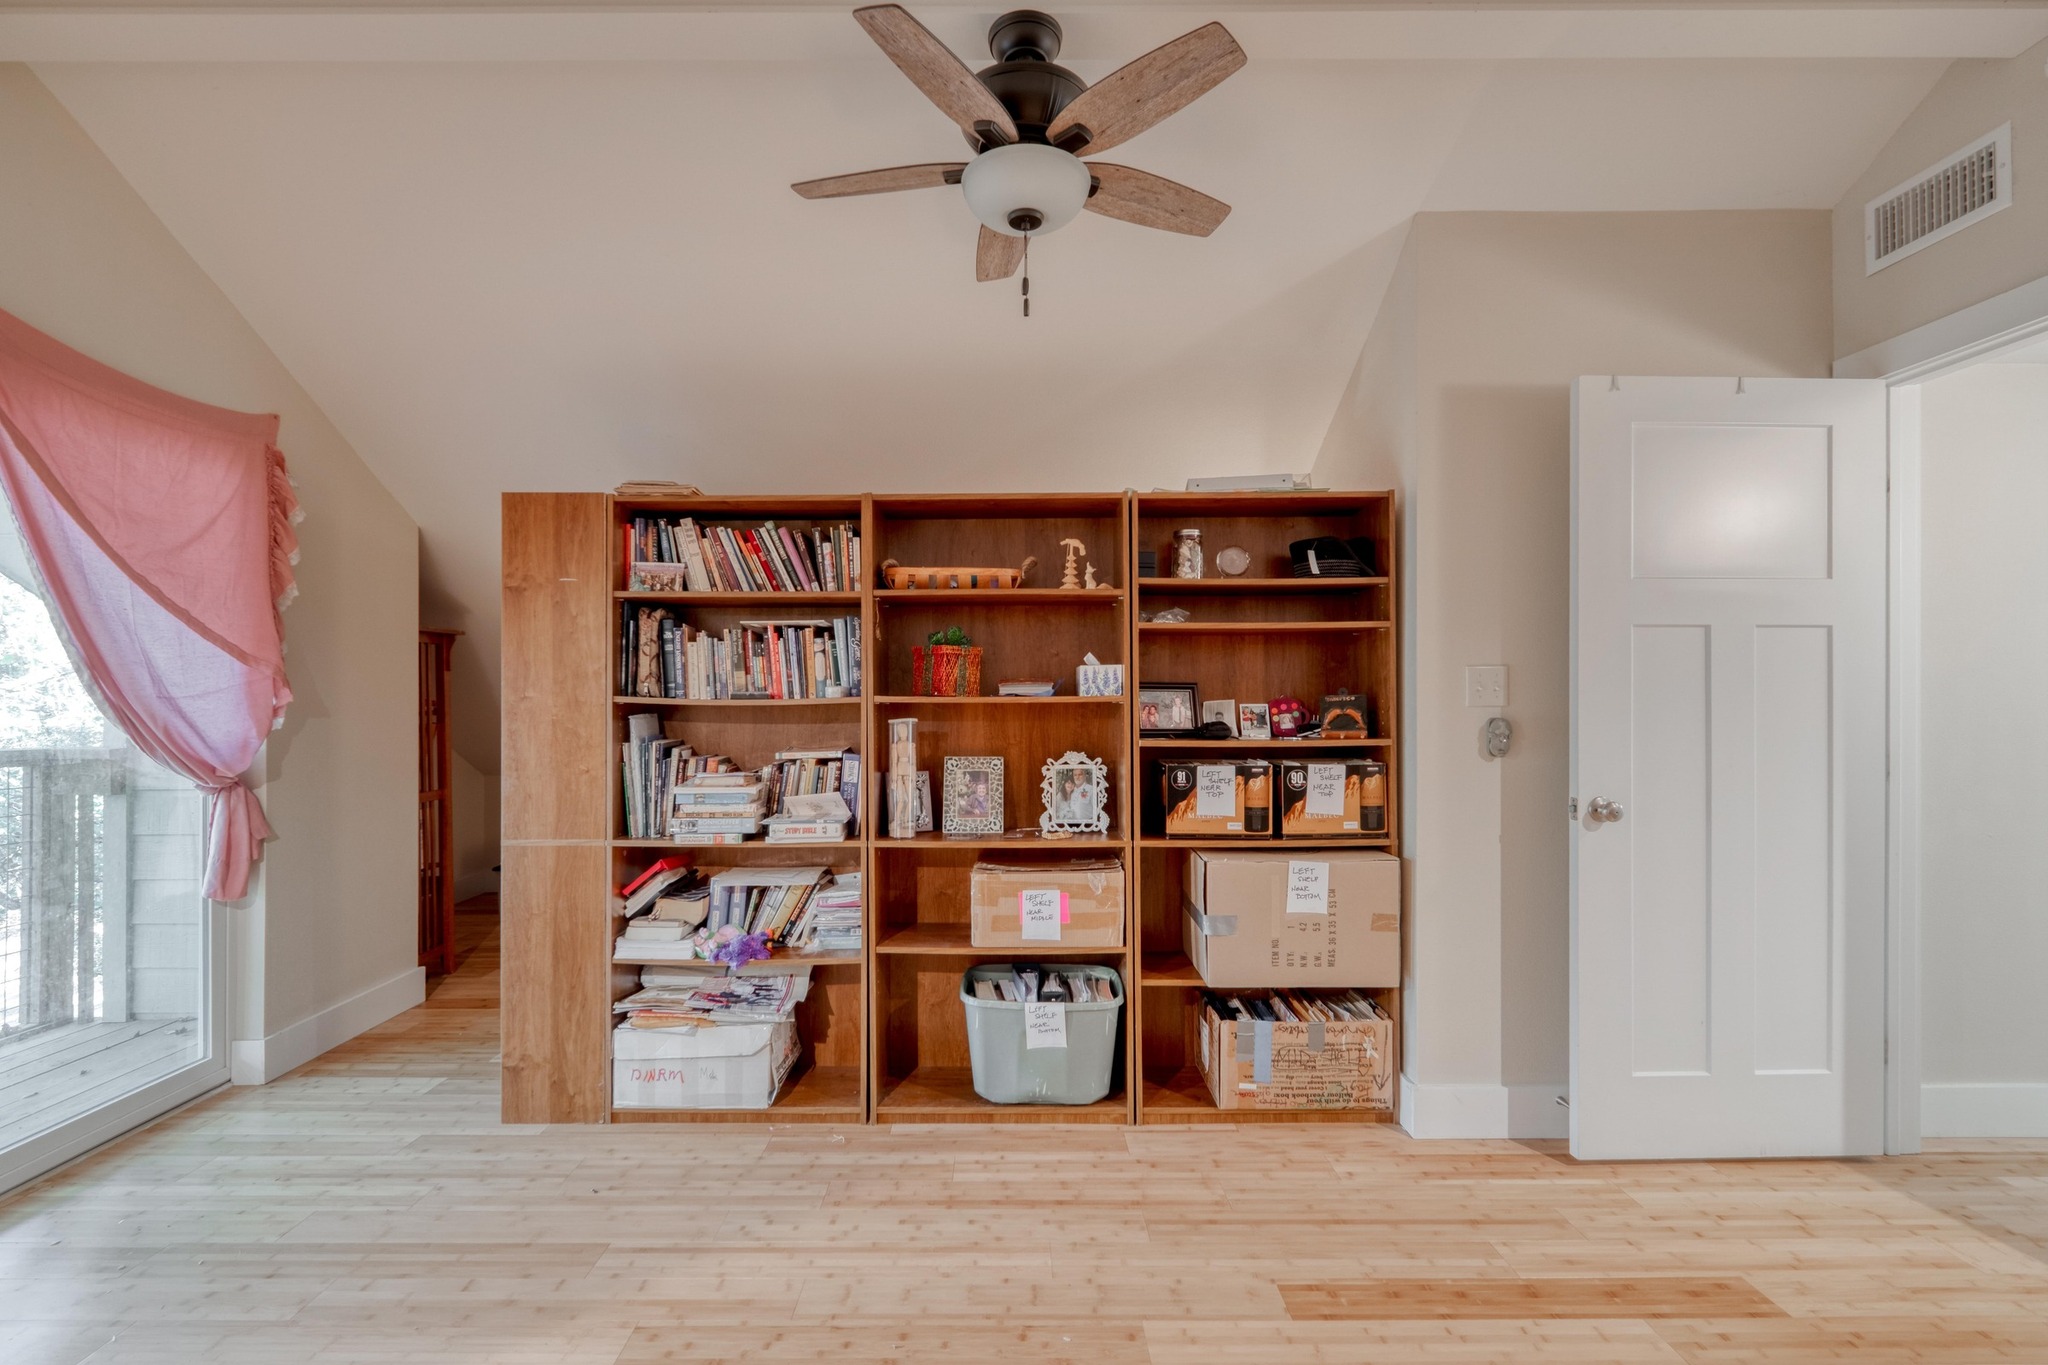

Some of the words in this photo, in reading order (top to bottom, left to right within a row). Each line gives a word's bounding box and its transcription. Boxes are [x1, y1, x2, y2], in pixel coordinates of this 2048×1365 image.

[850, 638, 861, 661] Gems
[1201, 770, 1221, 778] LEFT
[1313, 766, 1334, 775] LEFT
[1177, 771, 1186, 781] 91
[1291, 771, 1303, 784] 90
[1208, 778, 1233, 786] SHELF
[1292, 867, 1315, 875] LEFT
[1025, 893, 1047, 902] LEFT
[1328, 888, 1336, 898] CM
[1031, 899, 1054, 907] SHELF
[1328, 900, 1337, 909] 53
[1026, 908, 1043, 916] NEAR
[1328, 920, 1337, 929] 35
[1328, 937, 1337, 946] 36
[1271, 951, 1280, 967] ITEM
[1028, 1005, 1047, 1013] LEFT
